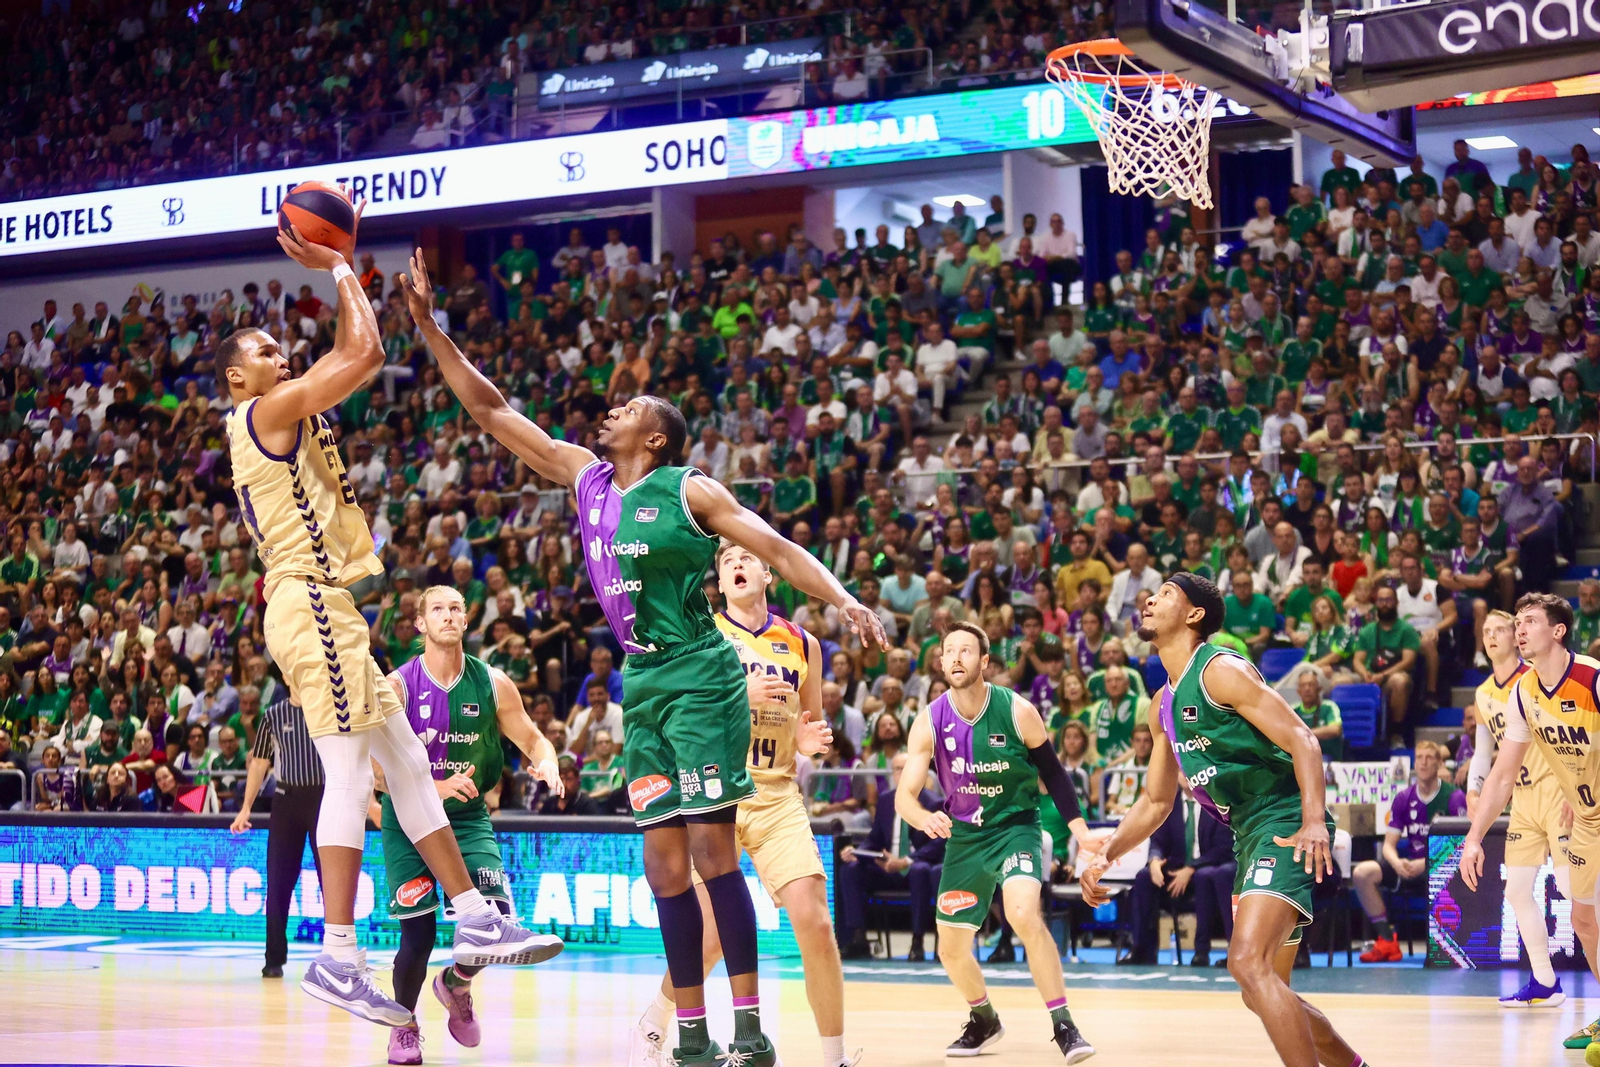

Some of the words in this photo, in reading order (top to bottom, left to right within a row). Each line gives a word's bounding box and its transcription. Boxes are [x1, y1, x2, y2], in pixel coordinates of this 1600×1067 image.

[1022, 89, 1065, 140] 10
[802, 114, 940, 154] UNICAJA
[645, 135, 726, 173] SOHO
[25, 205, 113, 242] HOTELS
[439, 732, 480, 746] Unicaja
[752, 738, 777, 769] 14
[966, 759, 1010, 774] Unicaja
[1577, 783, 1596, 807] 0
[971, 805, 985, 827] 4
[114, 865, 375, 920] DEDICDO
